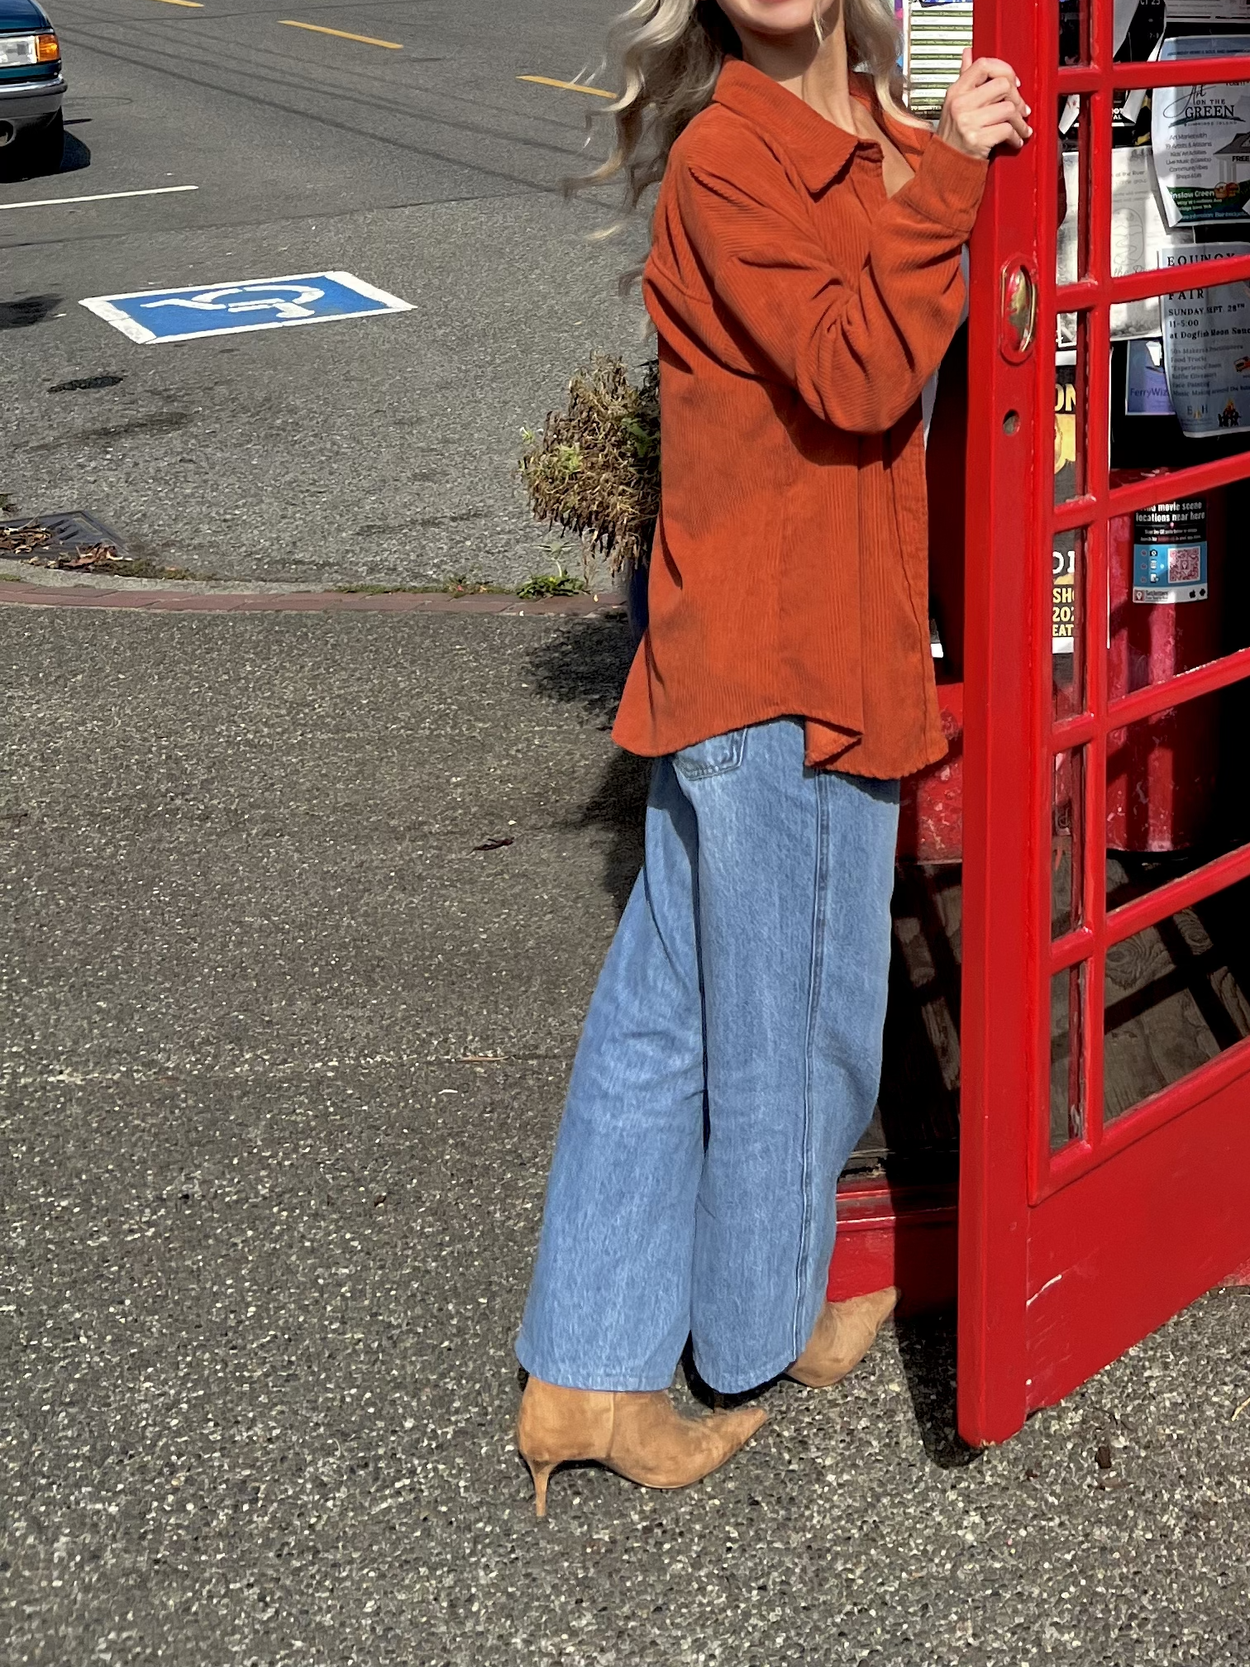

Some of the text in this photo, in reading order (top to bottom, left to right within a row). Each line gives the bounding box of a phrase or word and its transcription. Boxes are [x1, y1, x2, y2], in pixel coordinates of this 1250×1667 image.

[1185, 105, 1235, 119] GREEN
[1171, 190, 1215, 199] inslow Green
[1167, 253, 1235, 267] EQUIN
[1168, 307, 1204, 316] SUNDAY
[1158, 501, 1180, 512] movie
[1135, 512, 1170, 522] locations
[1190, 511, 1206, 520] here
[1053, 587, 1075, 603] SH
